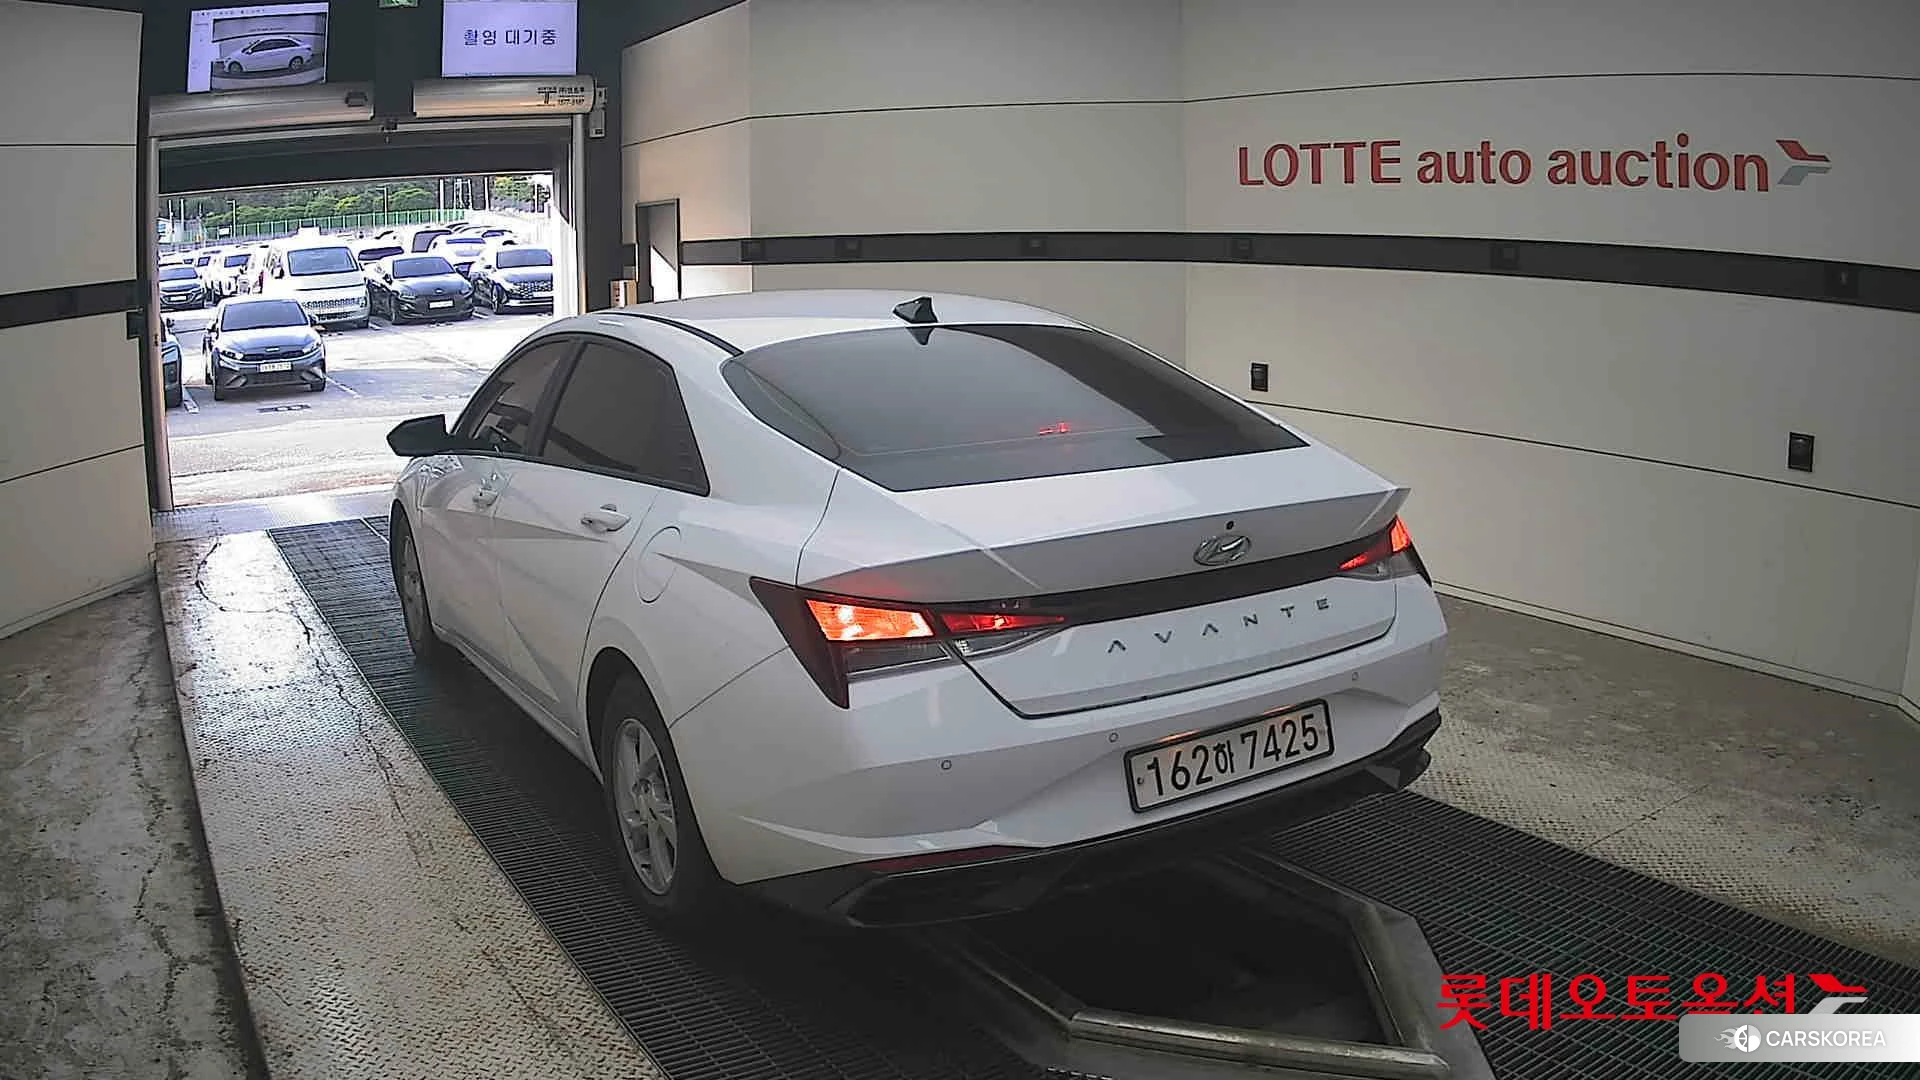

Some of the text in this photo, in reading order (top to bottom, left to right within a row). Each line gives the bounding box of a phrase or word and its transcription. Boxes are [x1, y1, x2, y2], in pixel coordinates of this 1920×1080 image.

[464, 29, 557, 46] 촬영 대기중
[1239, 132, 1769, 192] LOTTE auto auction
[1108, 598, 1330, 653] AVANTE
[1146, 713, 1320, 796] 162하 7425
